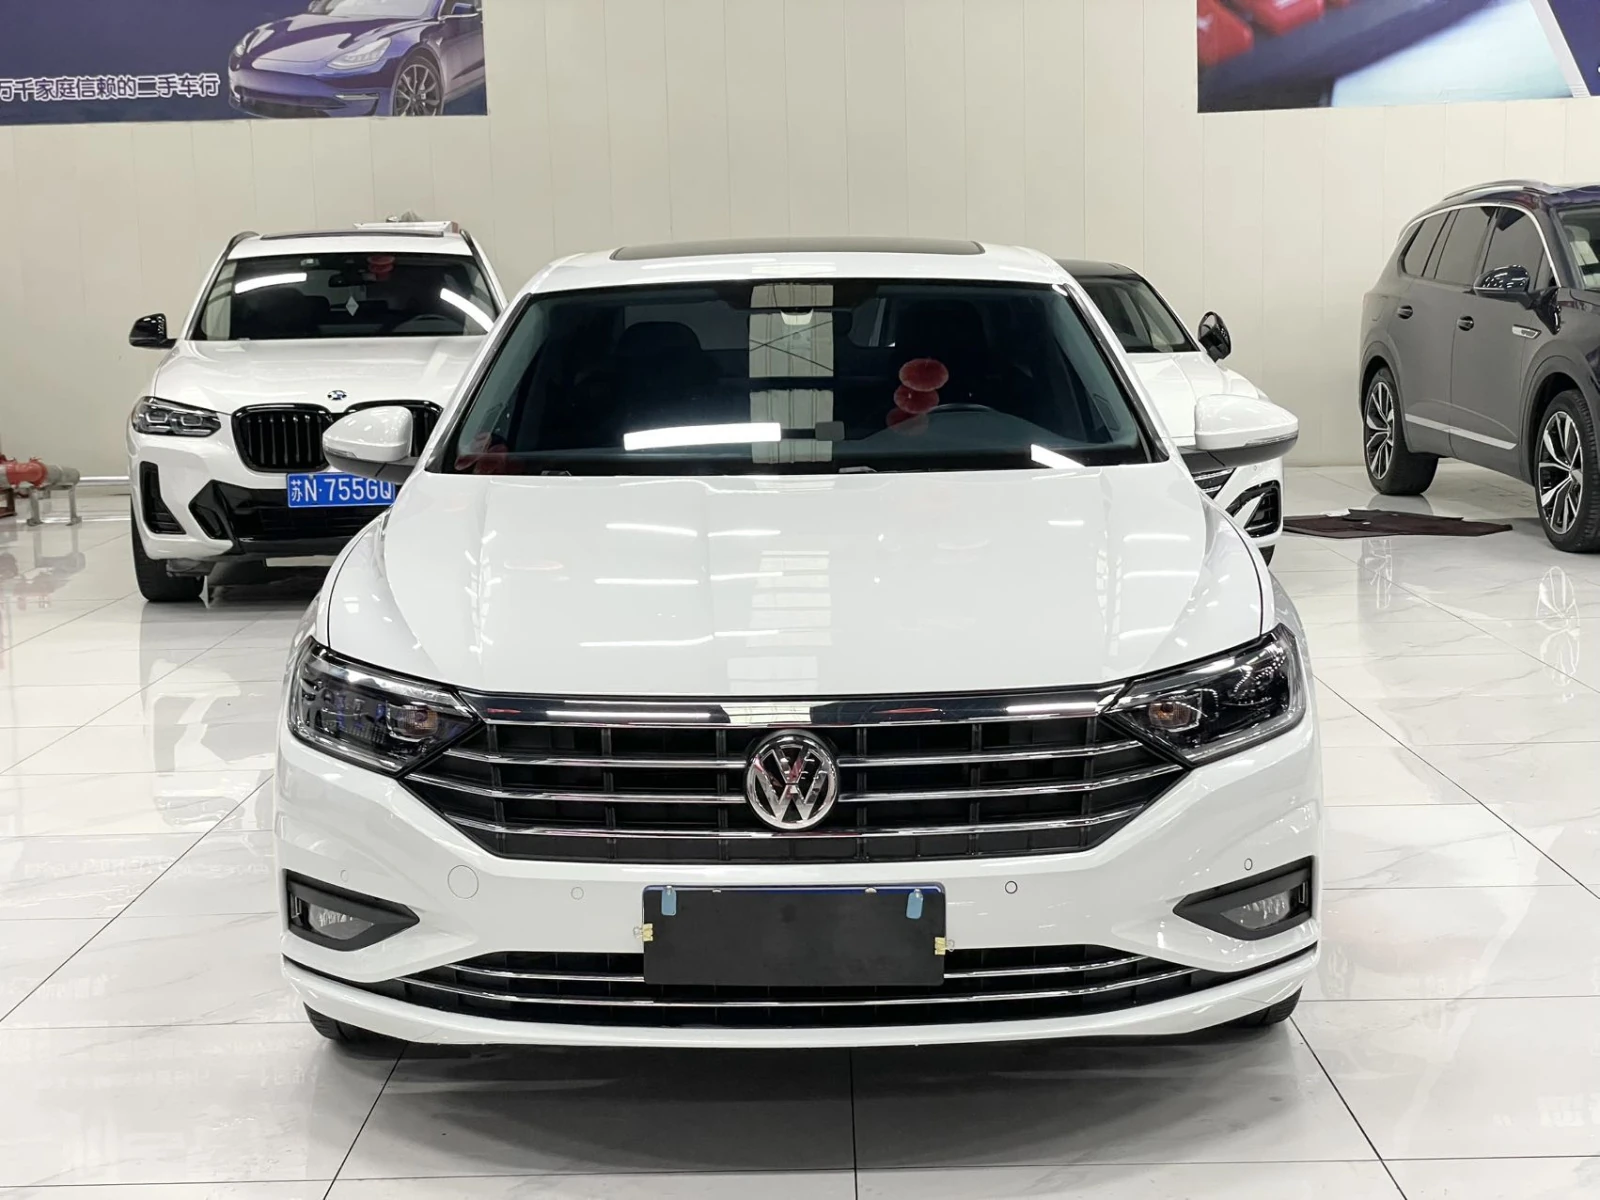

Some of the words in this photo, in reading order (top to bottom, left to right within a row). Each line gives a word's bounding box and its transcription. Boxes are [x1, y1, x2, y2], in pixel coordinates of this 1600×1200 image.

[0, 73, 220, 102] 万千家庭信赖的二手车行
